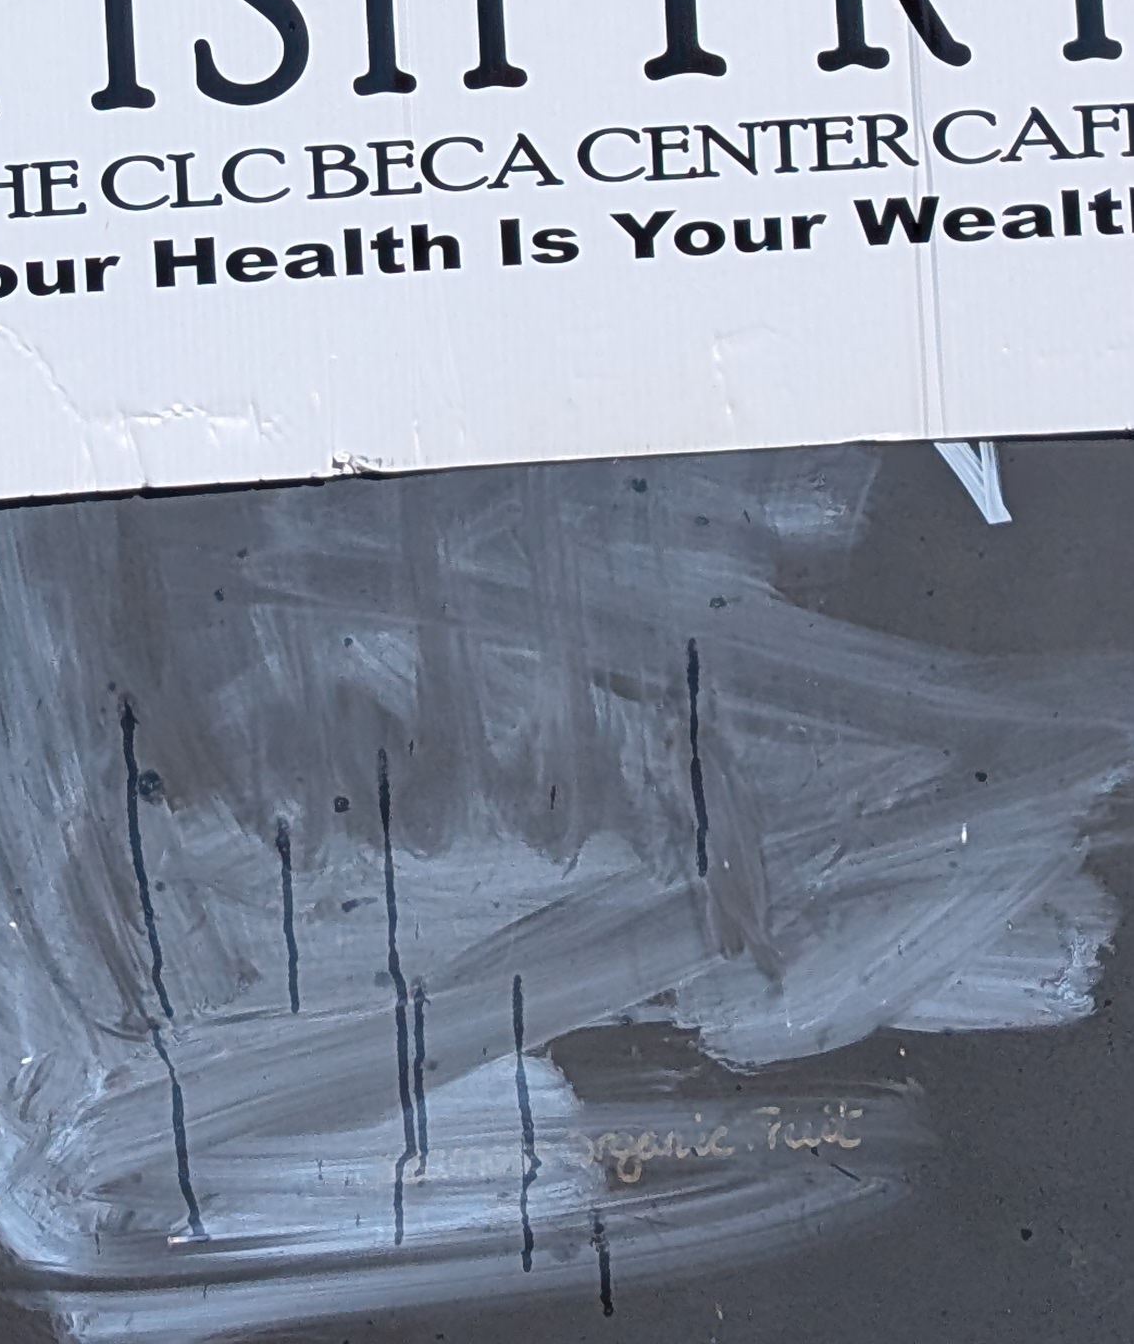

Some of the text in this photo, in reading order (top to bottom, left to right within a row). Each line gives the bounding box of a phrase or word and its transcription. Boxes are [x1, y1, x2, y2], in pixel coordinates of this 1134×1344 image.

[99, 144, 292, 212] CLC
[303, 132, 564, 200] BECA
[576, 113, 921, 183] CENTER
[152, 223, 463, 288] Health
[498, 218, 581, 266] Is
[609, 210, 828, 259] Your
[852, 186, 1134, 246] Wealt
